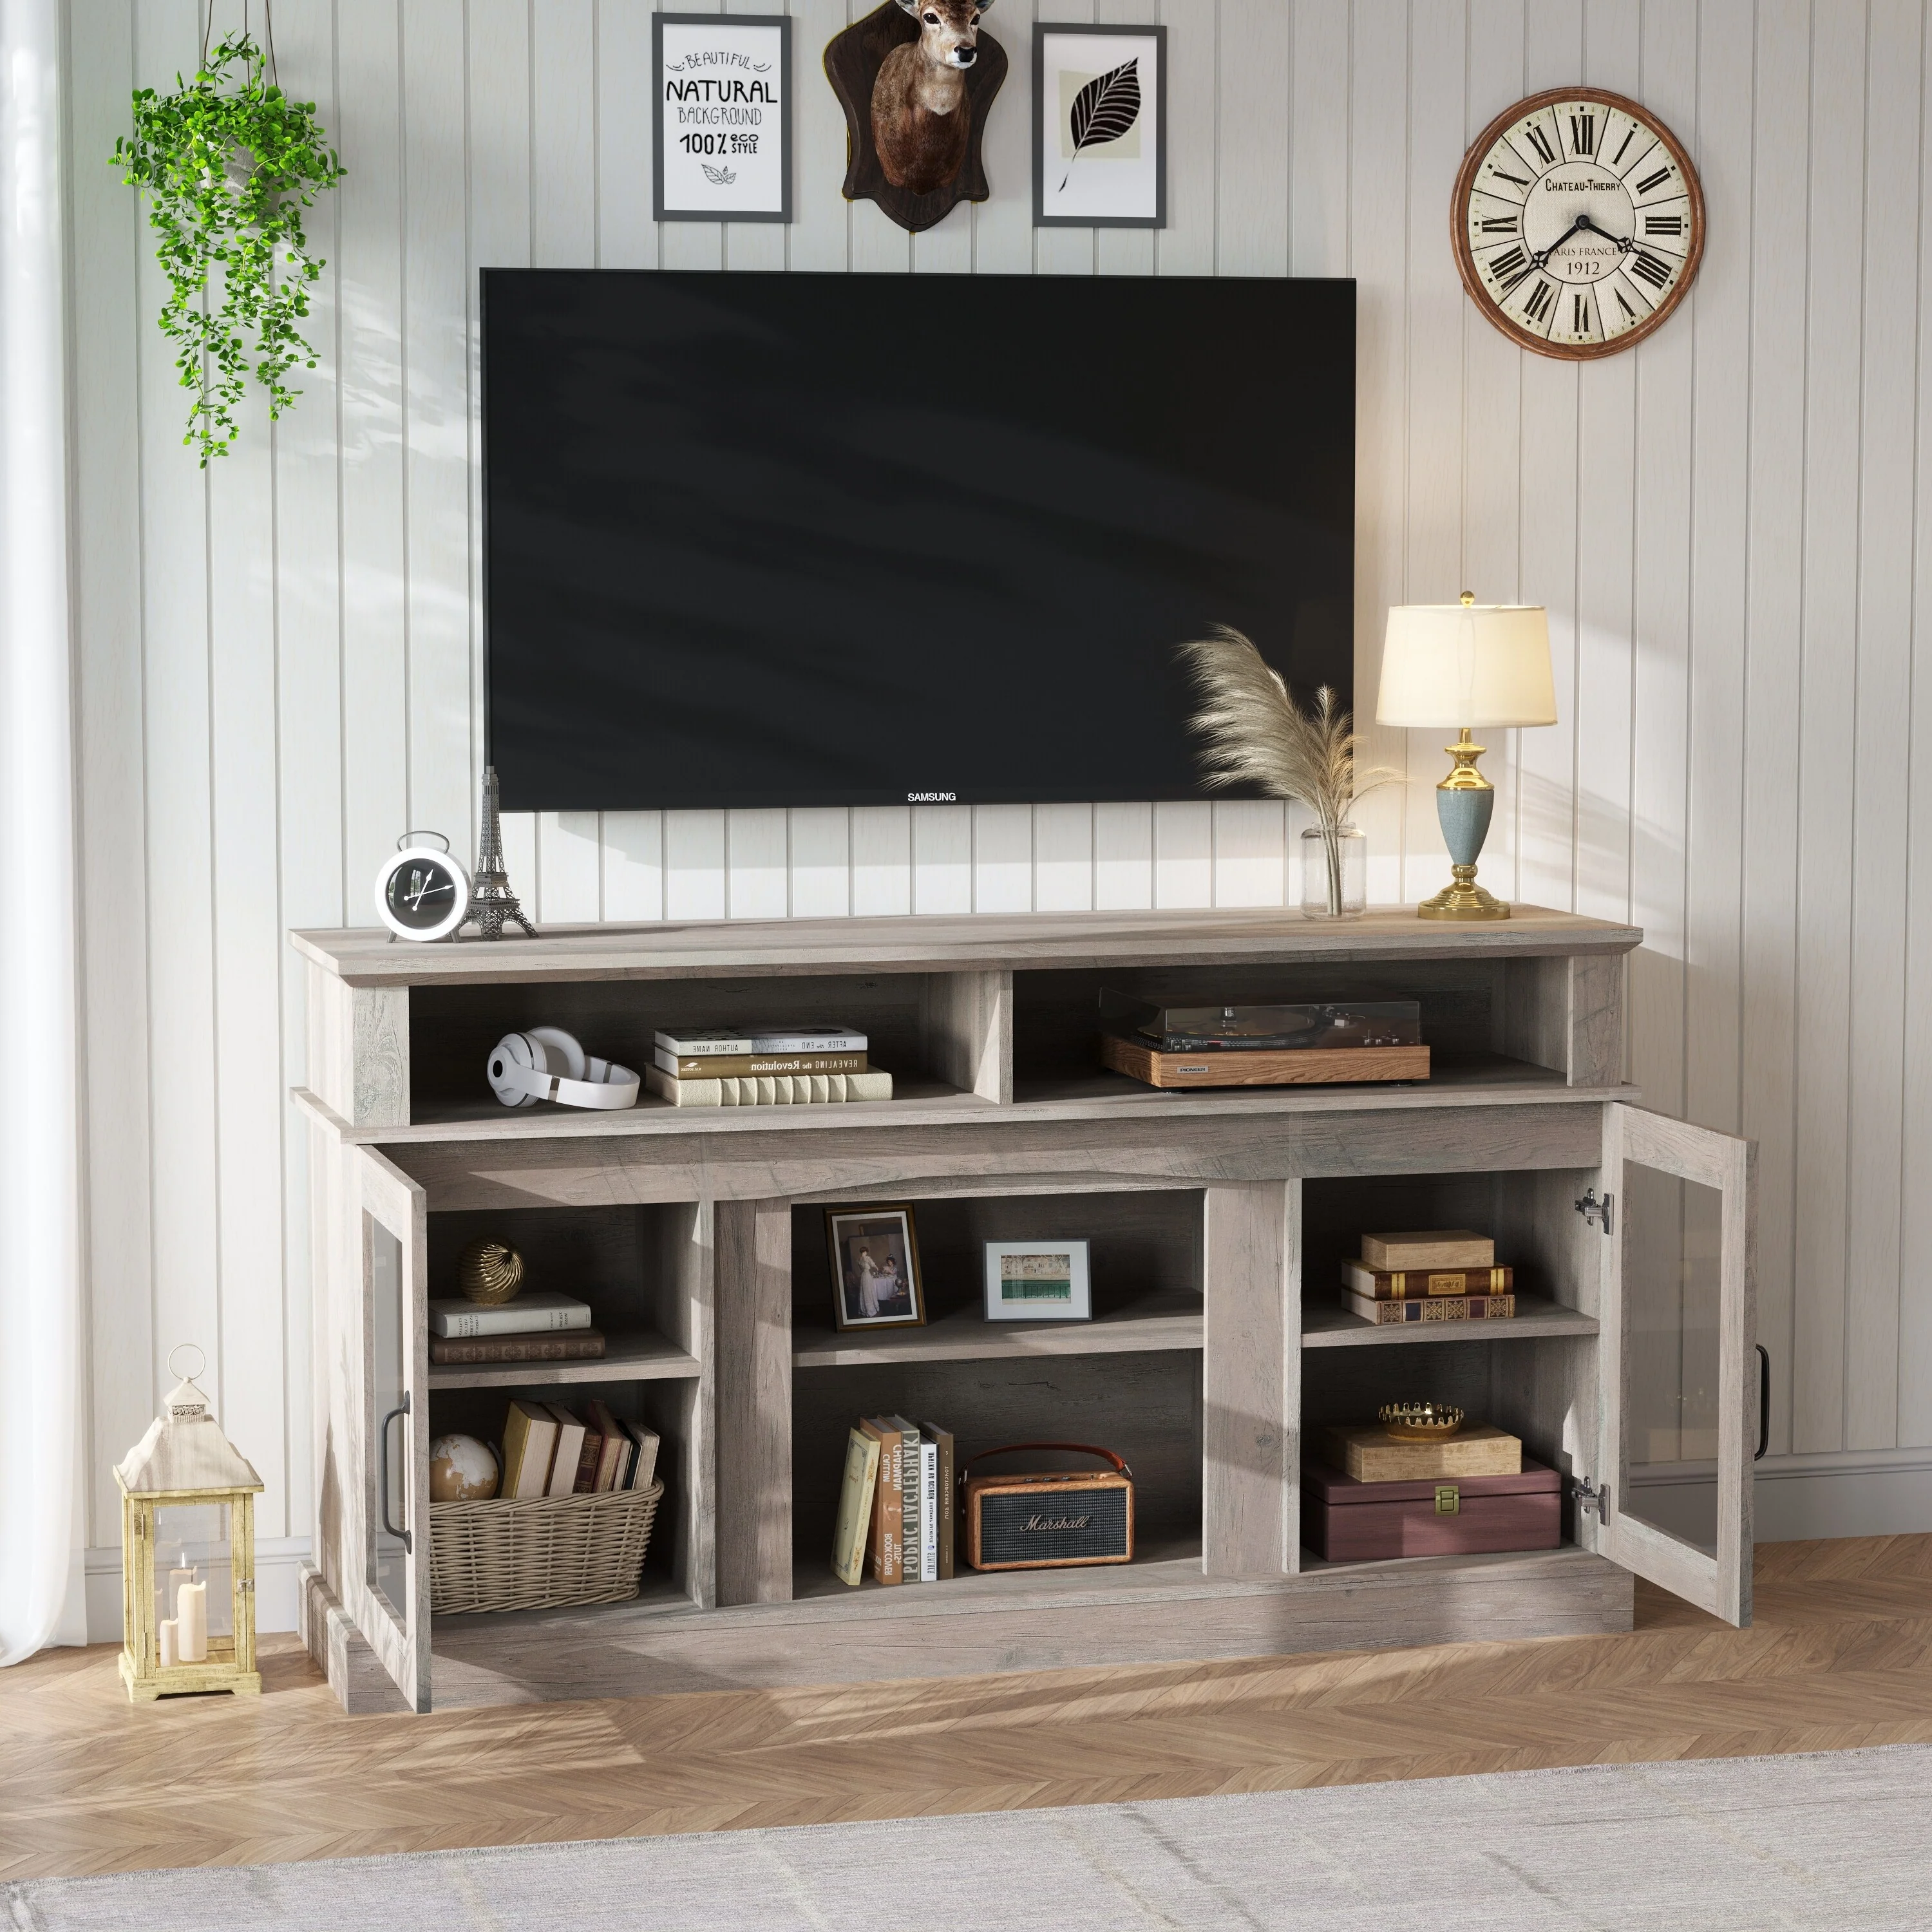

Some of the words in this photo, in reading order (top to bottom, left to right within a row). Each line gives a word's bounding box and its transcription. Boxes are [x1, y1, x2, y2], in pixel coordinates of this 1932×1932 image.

[685, 52, 750, 70] BEAUTIFUL
[666, 79, 777, 103] NATURAL
[677, 107, 762, 125] BACKGROUND
[679, 133, 726, 155] 100%
[730, 133, 759, 142] eco
[732, 142, 757, 154] STYLE
[1548, 247, 1576, 256] ARIS
[1579, 247, 1617, 256] FRANCE
[1566, 261, 1600, 275] 1912
[907, 792, 956, 802] SAMSUNG
[1019, 1515, 1090, 1531] Marshall
